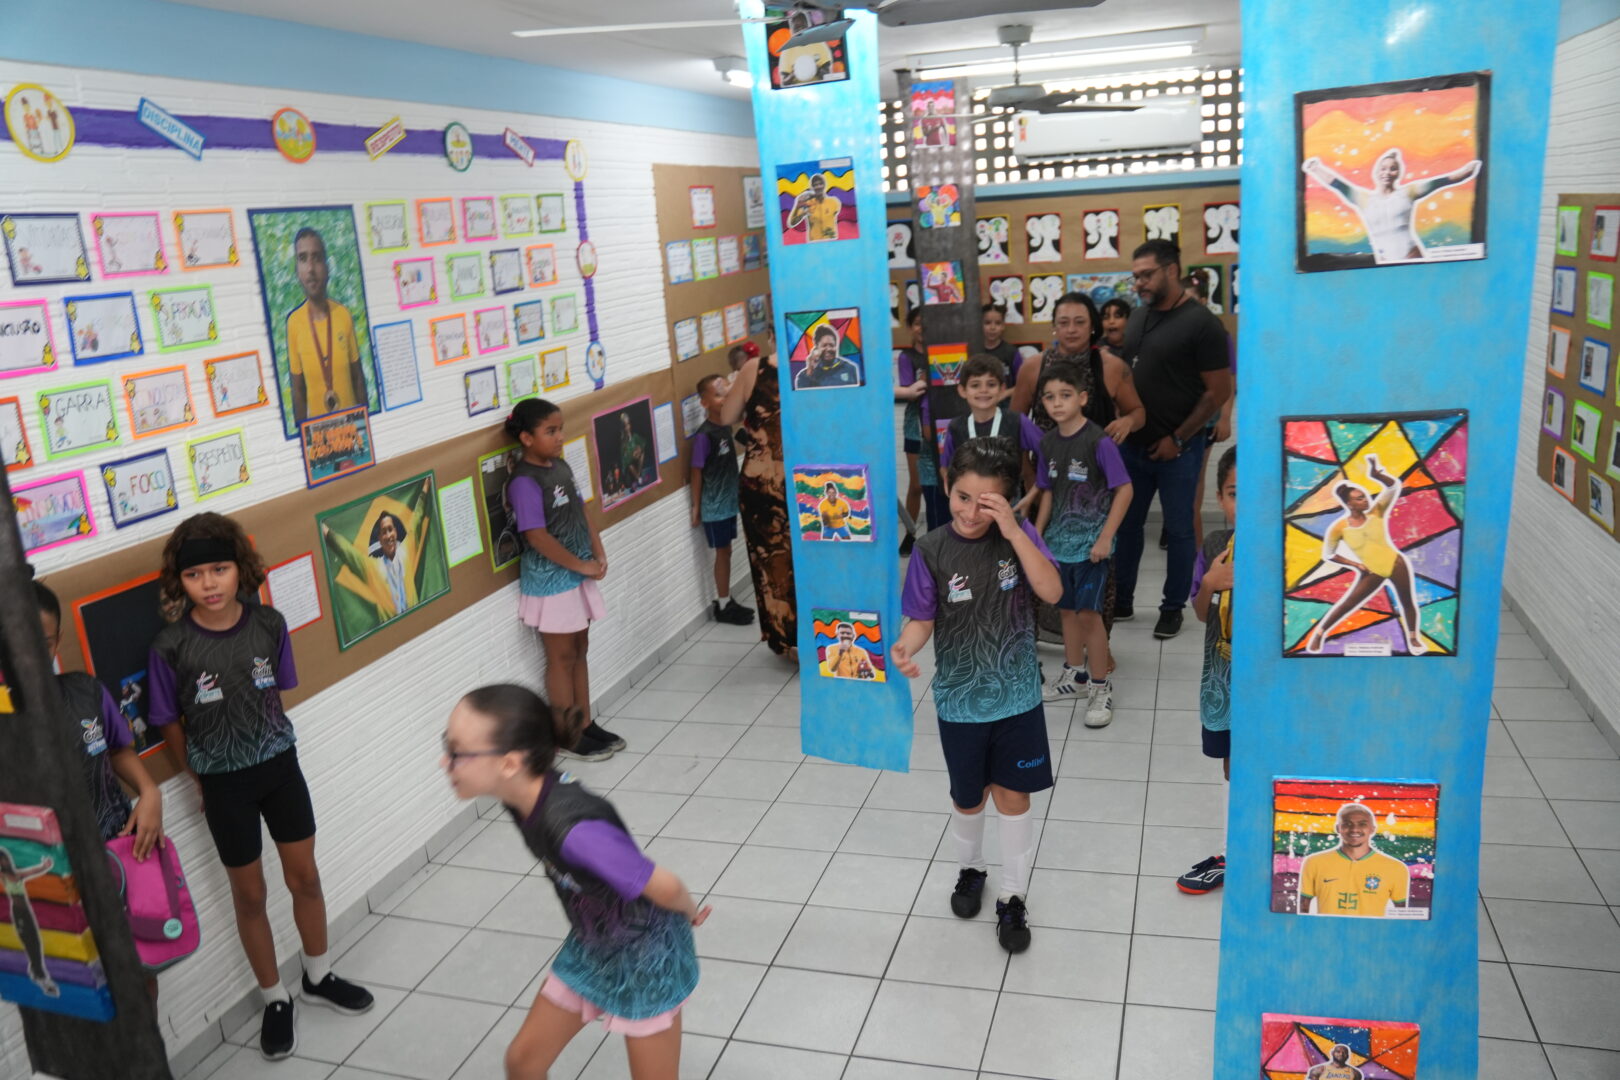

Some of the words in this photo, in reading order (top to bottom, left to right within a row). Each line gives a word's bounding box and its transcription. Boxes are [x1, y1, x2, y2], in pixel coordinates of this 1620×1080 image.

[55, 393, 106, 418] GARRA
[129, 470, 166, 497] FOCO
[1337, 892, 1359, 911] 25
